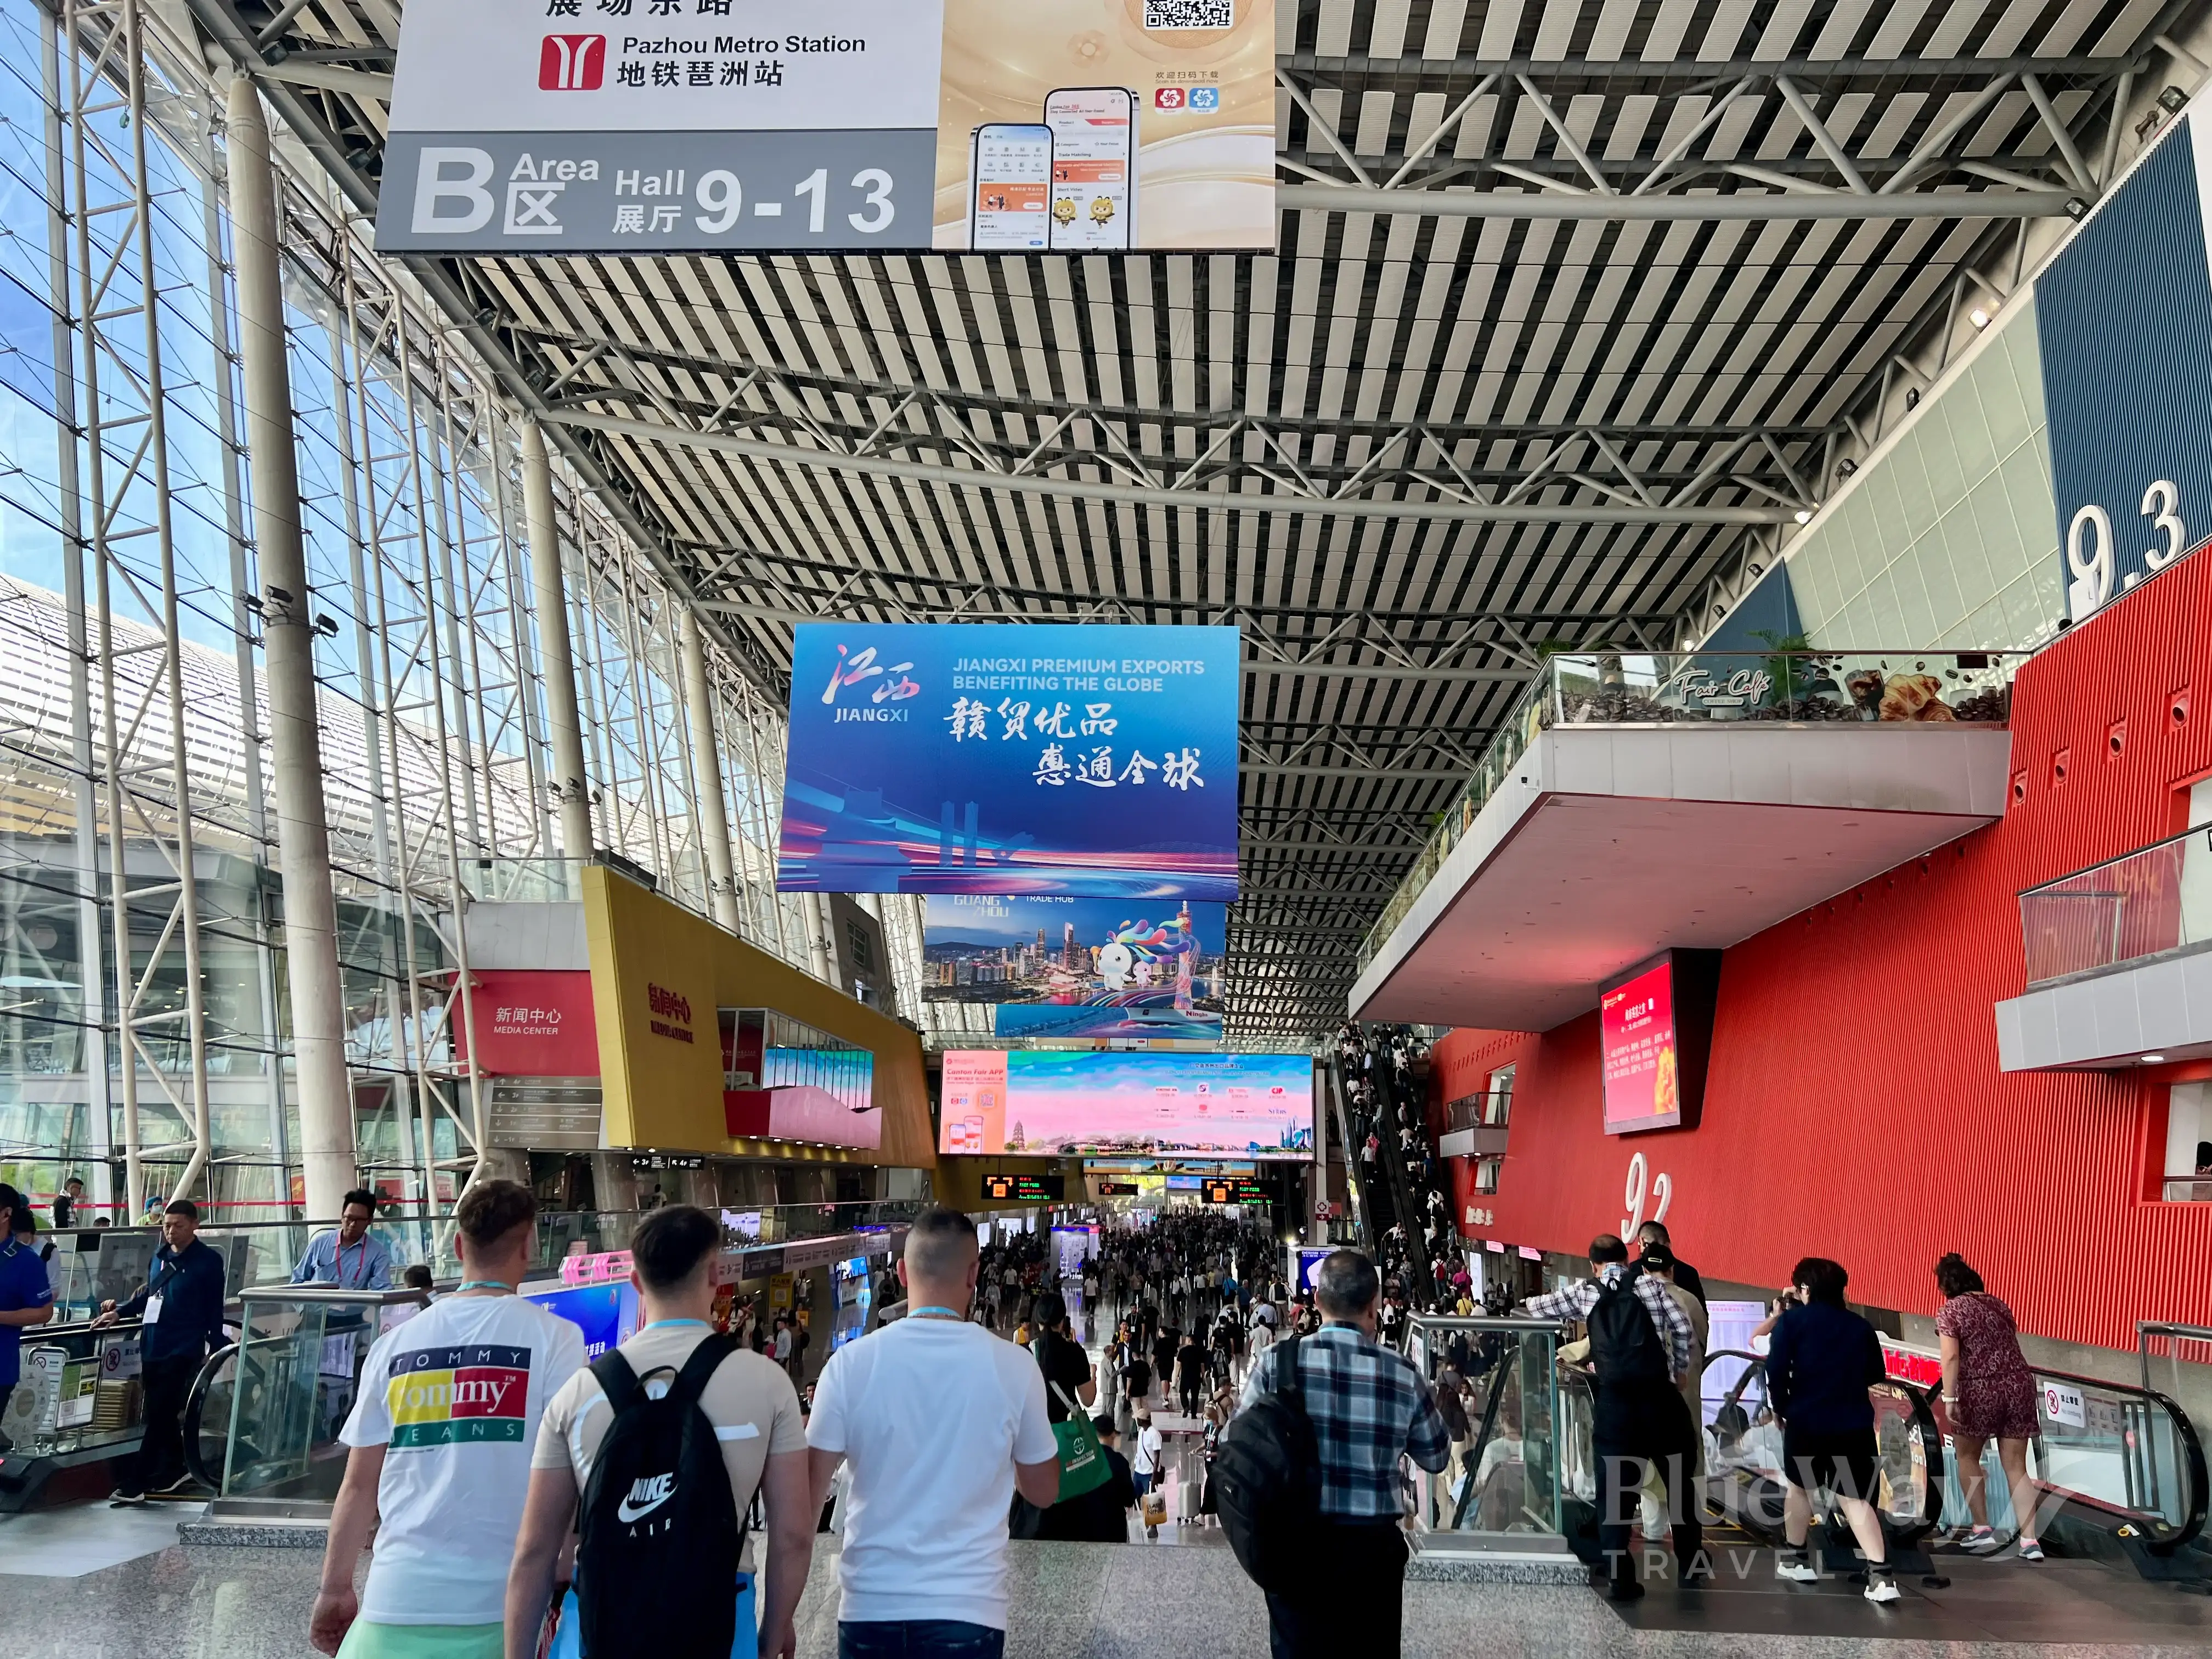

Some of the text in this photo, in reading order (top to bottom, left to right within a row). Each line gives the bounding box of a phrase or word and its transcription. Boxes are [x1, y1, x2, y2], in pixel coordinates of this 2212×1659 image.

[623, 35, 865, 54] Pazhou Metro Station
[617, 60, 784, 87] 地铁琶洲站
[1155, 71, 1218, 79] 欢迎扫码下载
[411, 147, 599, 234] B Area
[615, 168, 895, 234] Hall 9-13
[503, 182, 566, 235] 区
[612, 205, 681, 234] 展厅
[821, 644, 920, 704] 江西
[953, 658, 1205, 675] JIANGXI PREMIUM EXPORTS
[953, 676, 1163, 692] BENEFITING THE GLOBE
[1673, 669, 1719, 704] Fair
[834, 708, 909, 723] JIANGXI
[1032, 742, 1204, 791] 惠通全球
[954, 895, 1000, 905] GUANG
[495, 1007, 562, 1024] 新闻中心
[494, 1025, 558, 1035] MEDIA CENTER
[396, 1350, 521, 1372] TOMMY
[628, 1471, 674, 1502] NIKE
[629, 1517, 672, 1538] AIR
